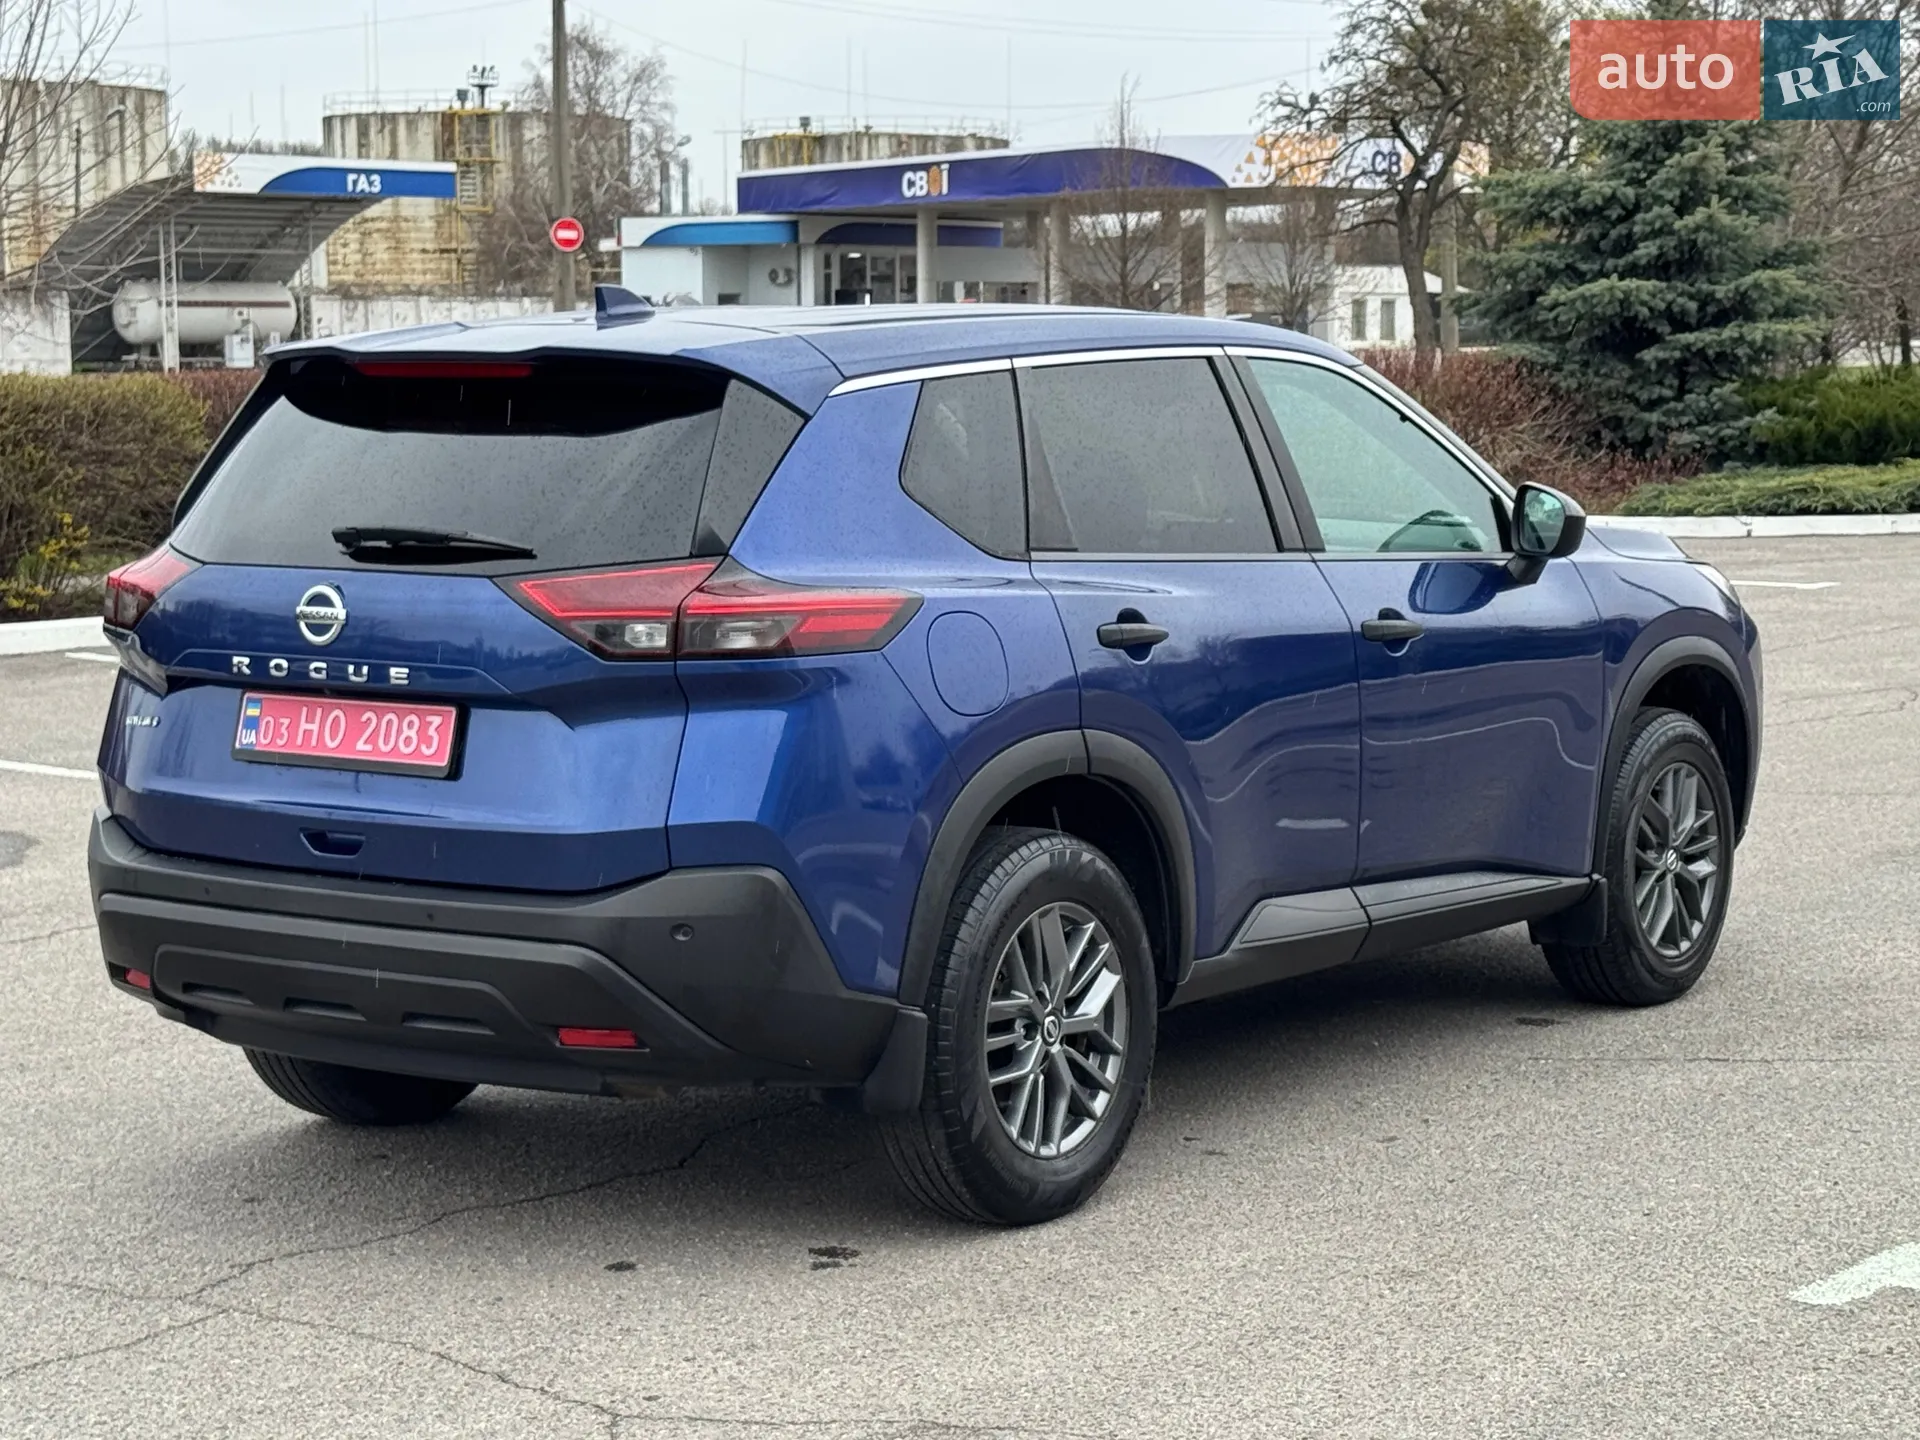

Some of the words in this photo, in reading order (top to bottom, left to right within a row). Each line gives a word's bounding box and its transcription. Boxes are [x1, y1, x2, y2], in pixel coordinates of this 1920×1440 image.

[346, 173, 382, 194] ГАЗ
[231, 655, 410, 686] ROGUE
[241, 728, 257, 745] UA
[259, 715, 292, 747] 03
[297, 705, 347, 749] HO
[355, 710, 444, 756] 2083
